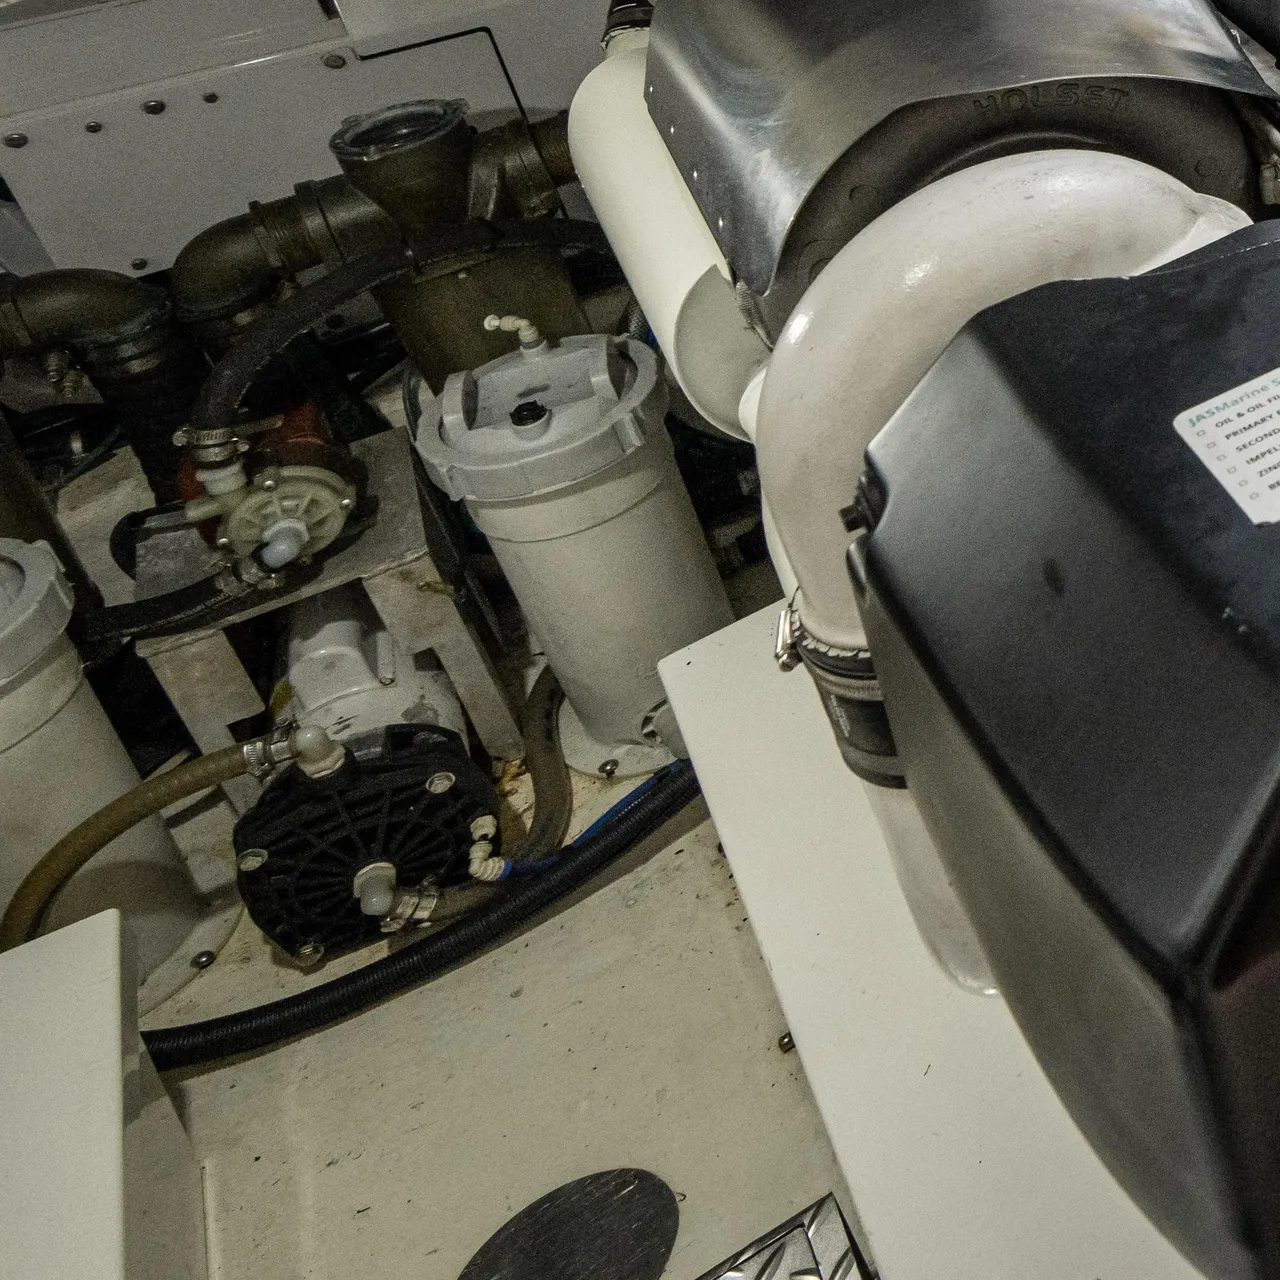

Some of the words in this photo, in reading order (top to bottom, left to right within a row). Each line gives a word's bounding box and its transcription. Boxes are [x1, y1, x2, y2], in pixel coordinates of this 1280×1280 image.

[1215, 416, 1234, 429] OIL
[1247, 402, 1266, 415] OIL
[1225, 413, 1273, 441] PRIMARY
